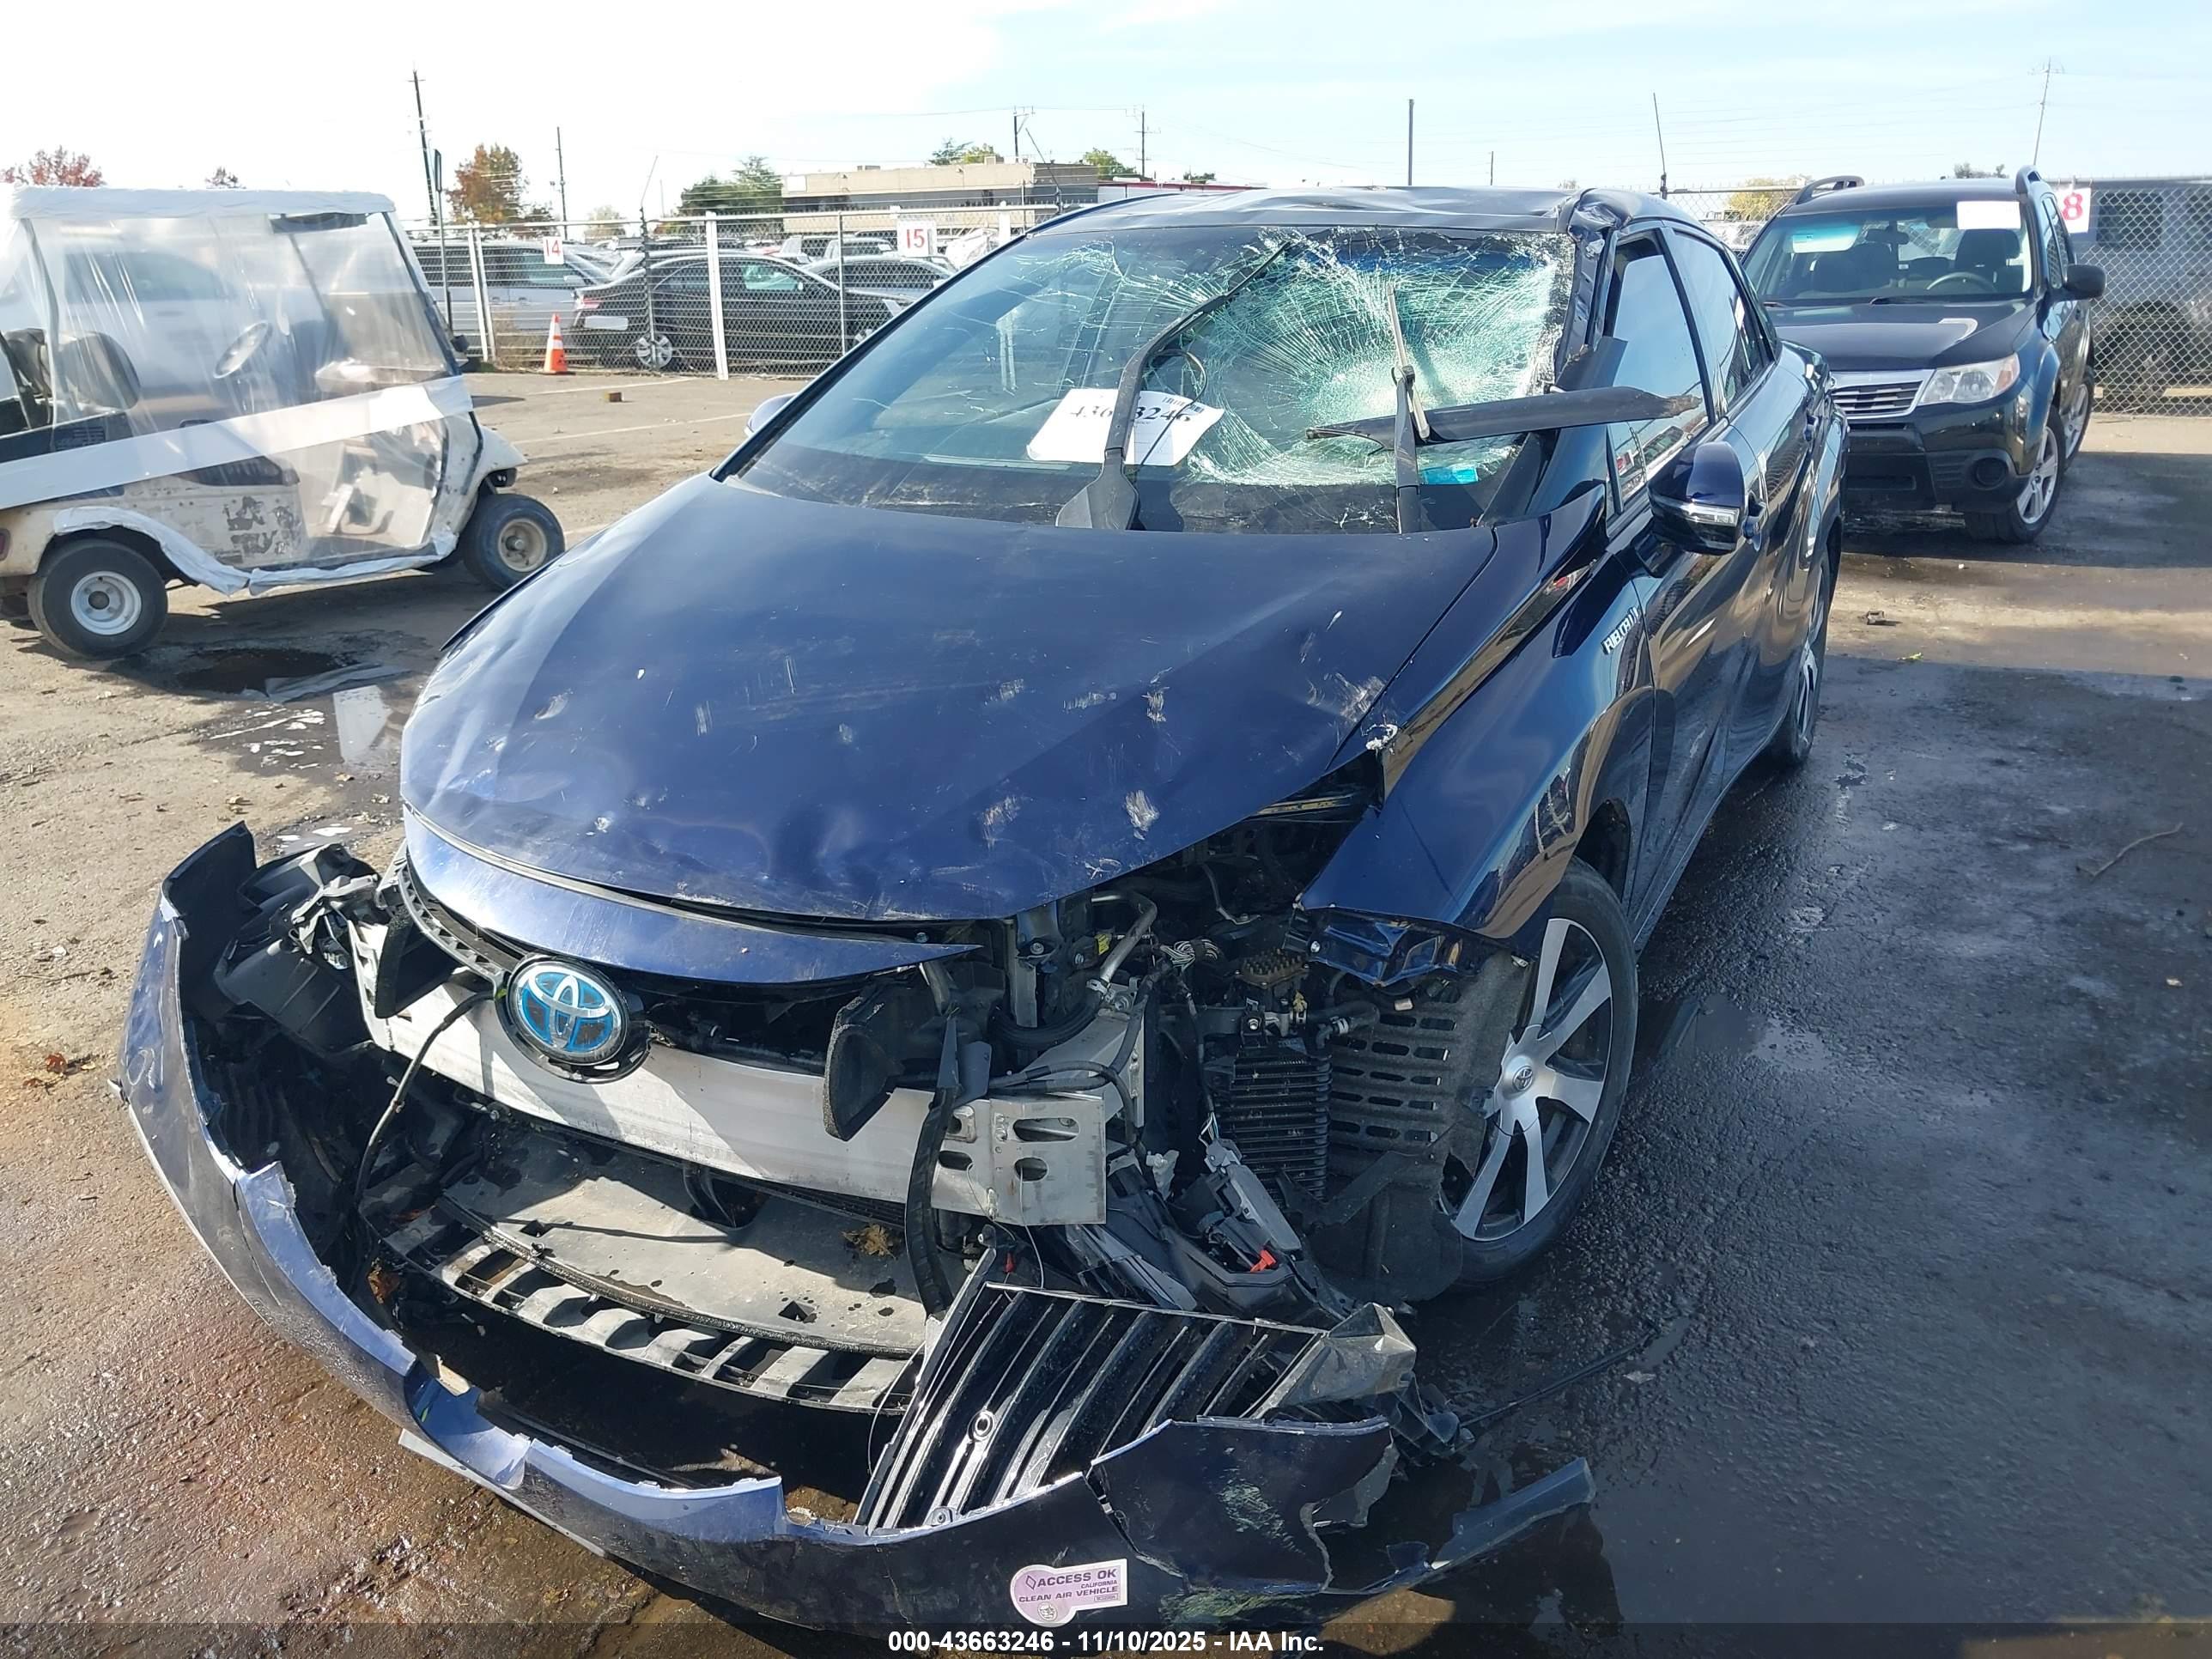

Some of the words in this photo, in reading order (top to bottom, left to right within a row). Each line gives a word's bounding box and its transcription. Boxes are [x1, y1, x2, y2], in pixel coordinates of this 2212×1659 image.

[906, 228, 926, 249] 15
[545, 239, 562, 257] 14
[1037, 1573, 1091, 1588] ACCESS
[1097, 1569, 1117, 1579] OK
[1080, 1580, 1117, 1589] CALIFORNIA
[1018, 1594, 1052, 1602] CLEAN
[1076, 1586, 1117, 1597] VEHICLE
